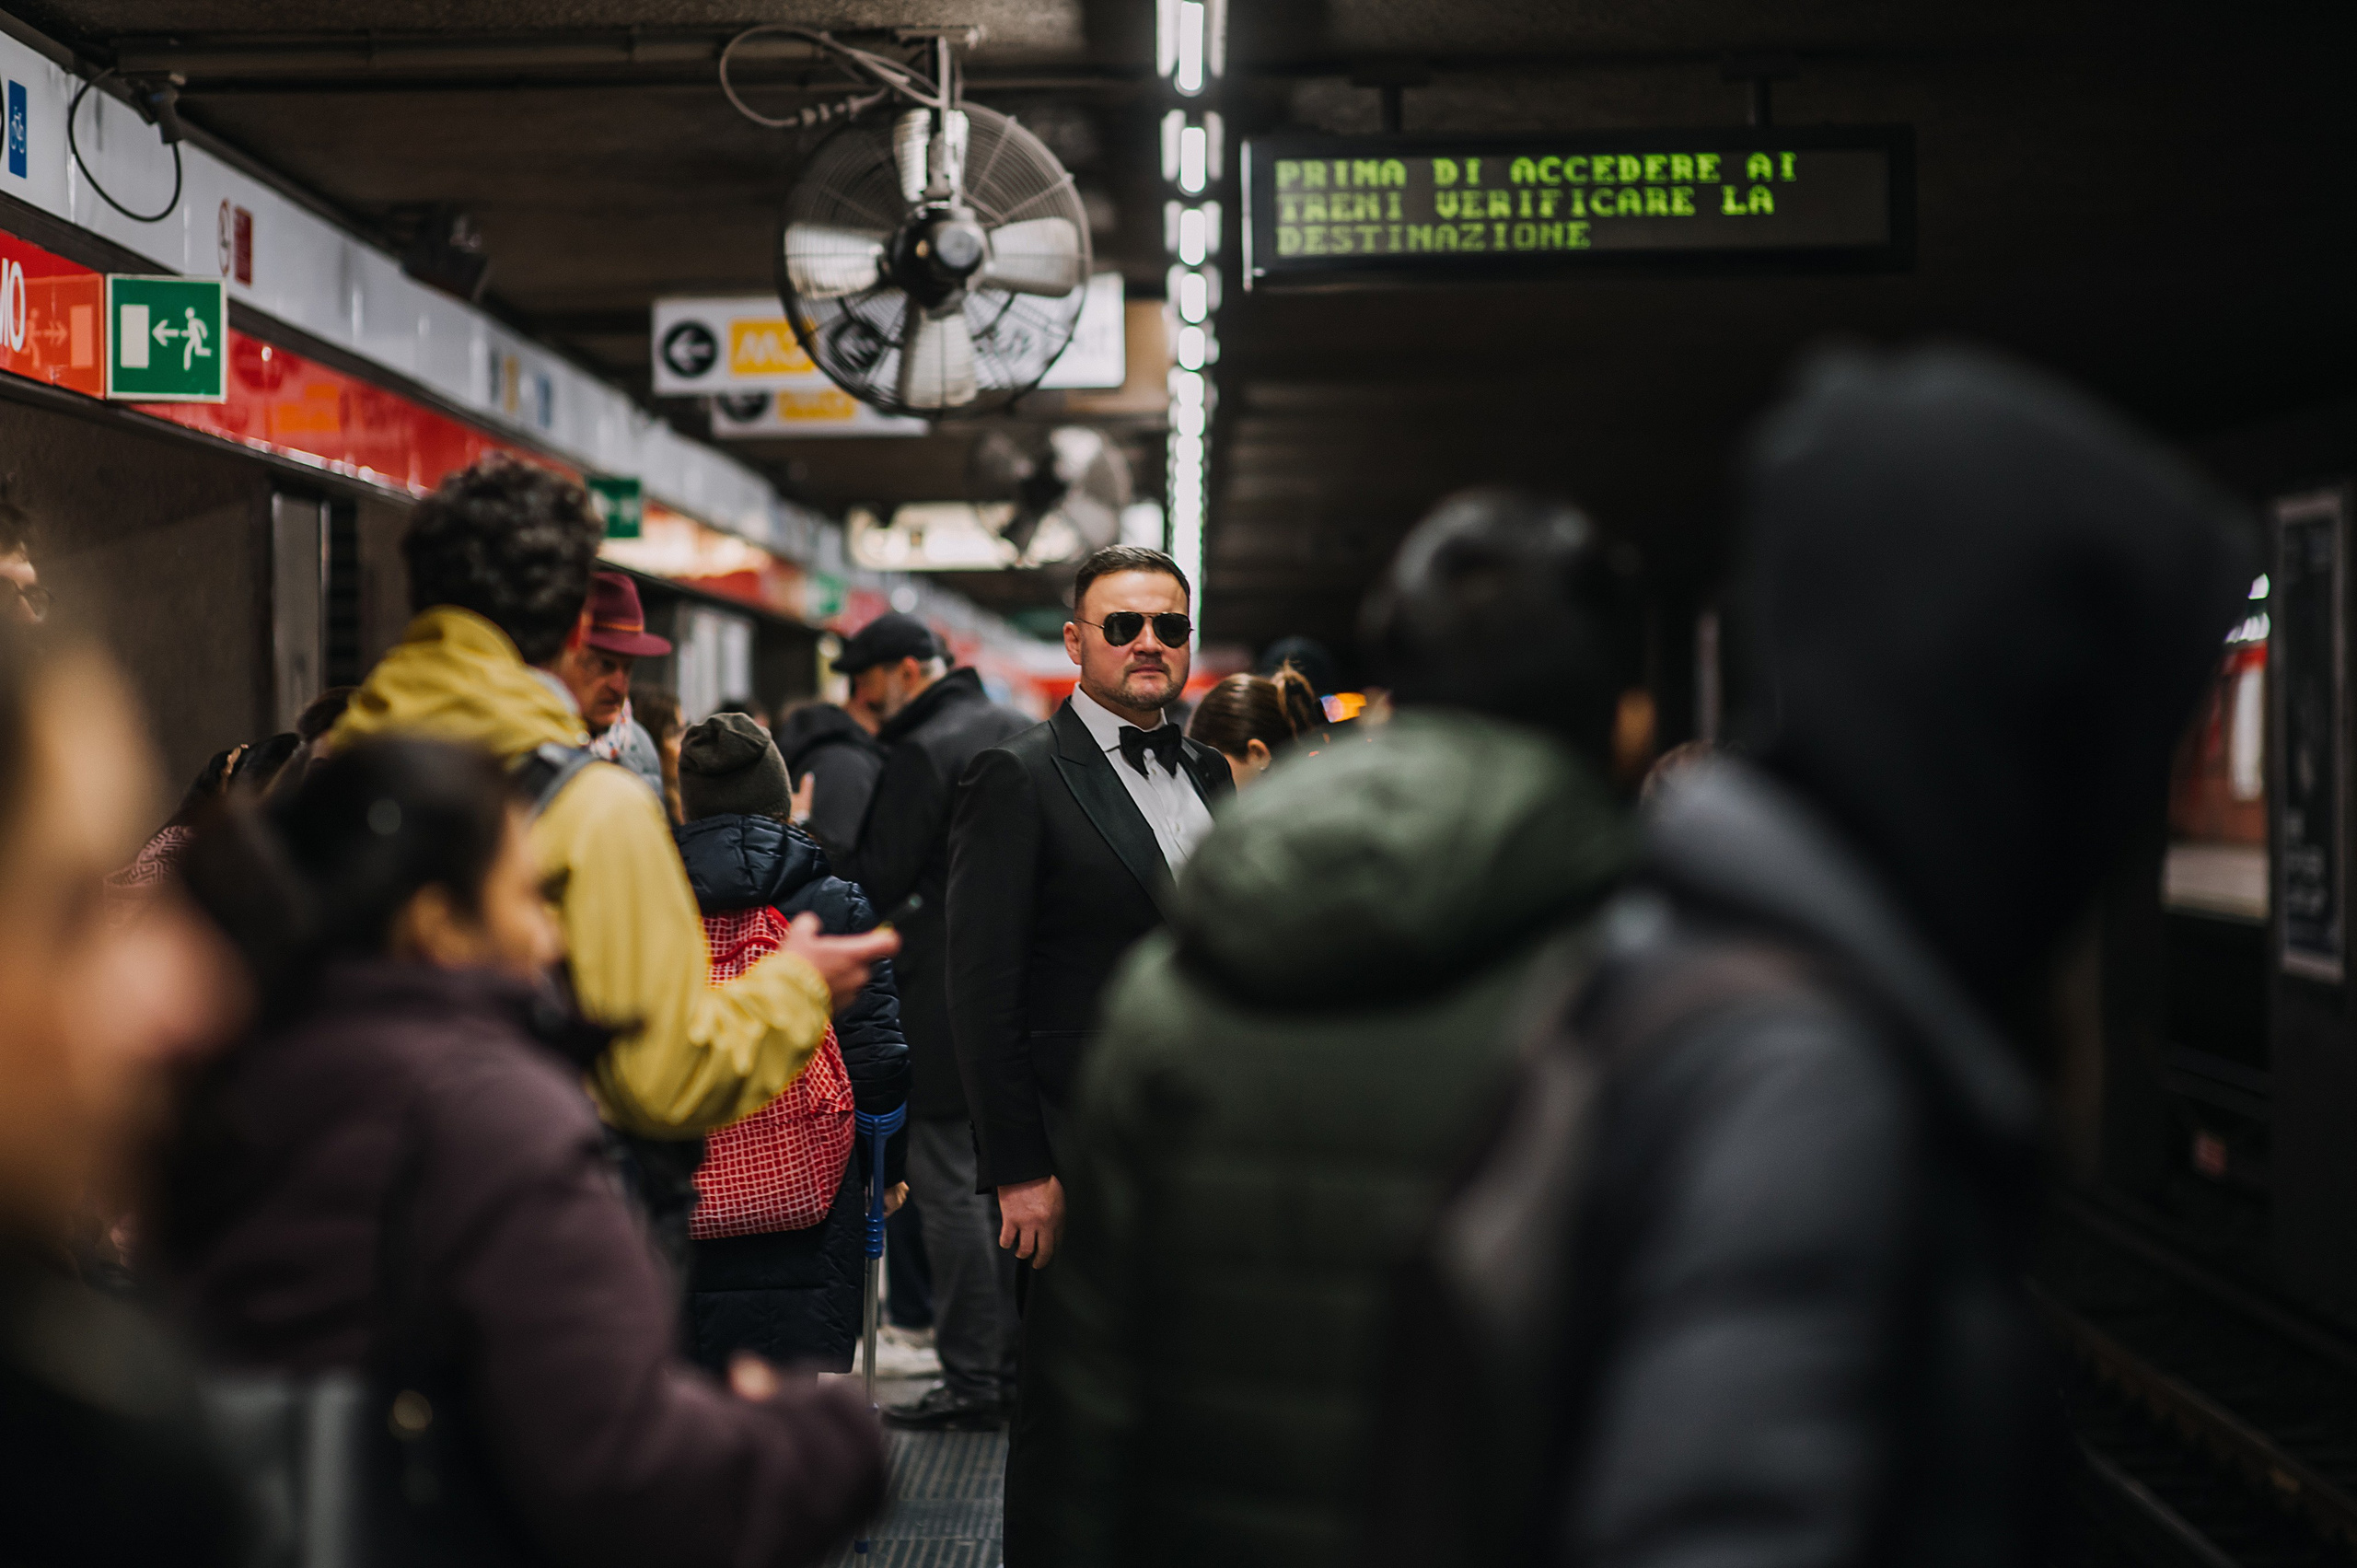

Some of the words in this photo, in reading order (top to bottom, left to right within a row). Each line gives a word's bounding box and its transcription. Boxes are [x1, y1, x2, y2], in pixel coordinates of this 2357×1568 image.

[1275, 158, 1407, 189] PRIMA
[1433, 157, 1480, 186] DI
[1510, 153, 1721, 185] ACCEDERE
[1746, 151, 1796, 182] AI
[1276, 191, 1401, 222] TRENI
[1434, 186, 1695, 219] VERIFICARE
[1721, 184, 1775, 215] LA
[1275, 220, 1591, 257] DESTINAZIONE
